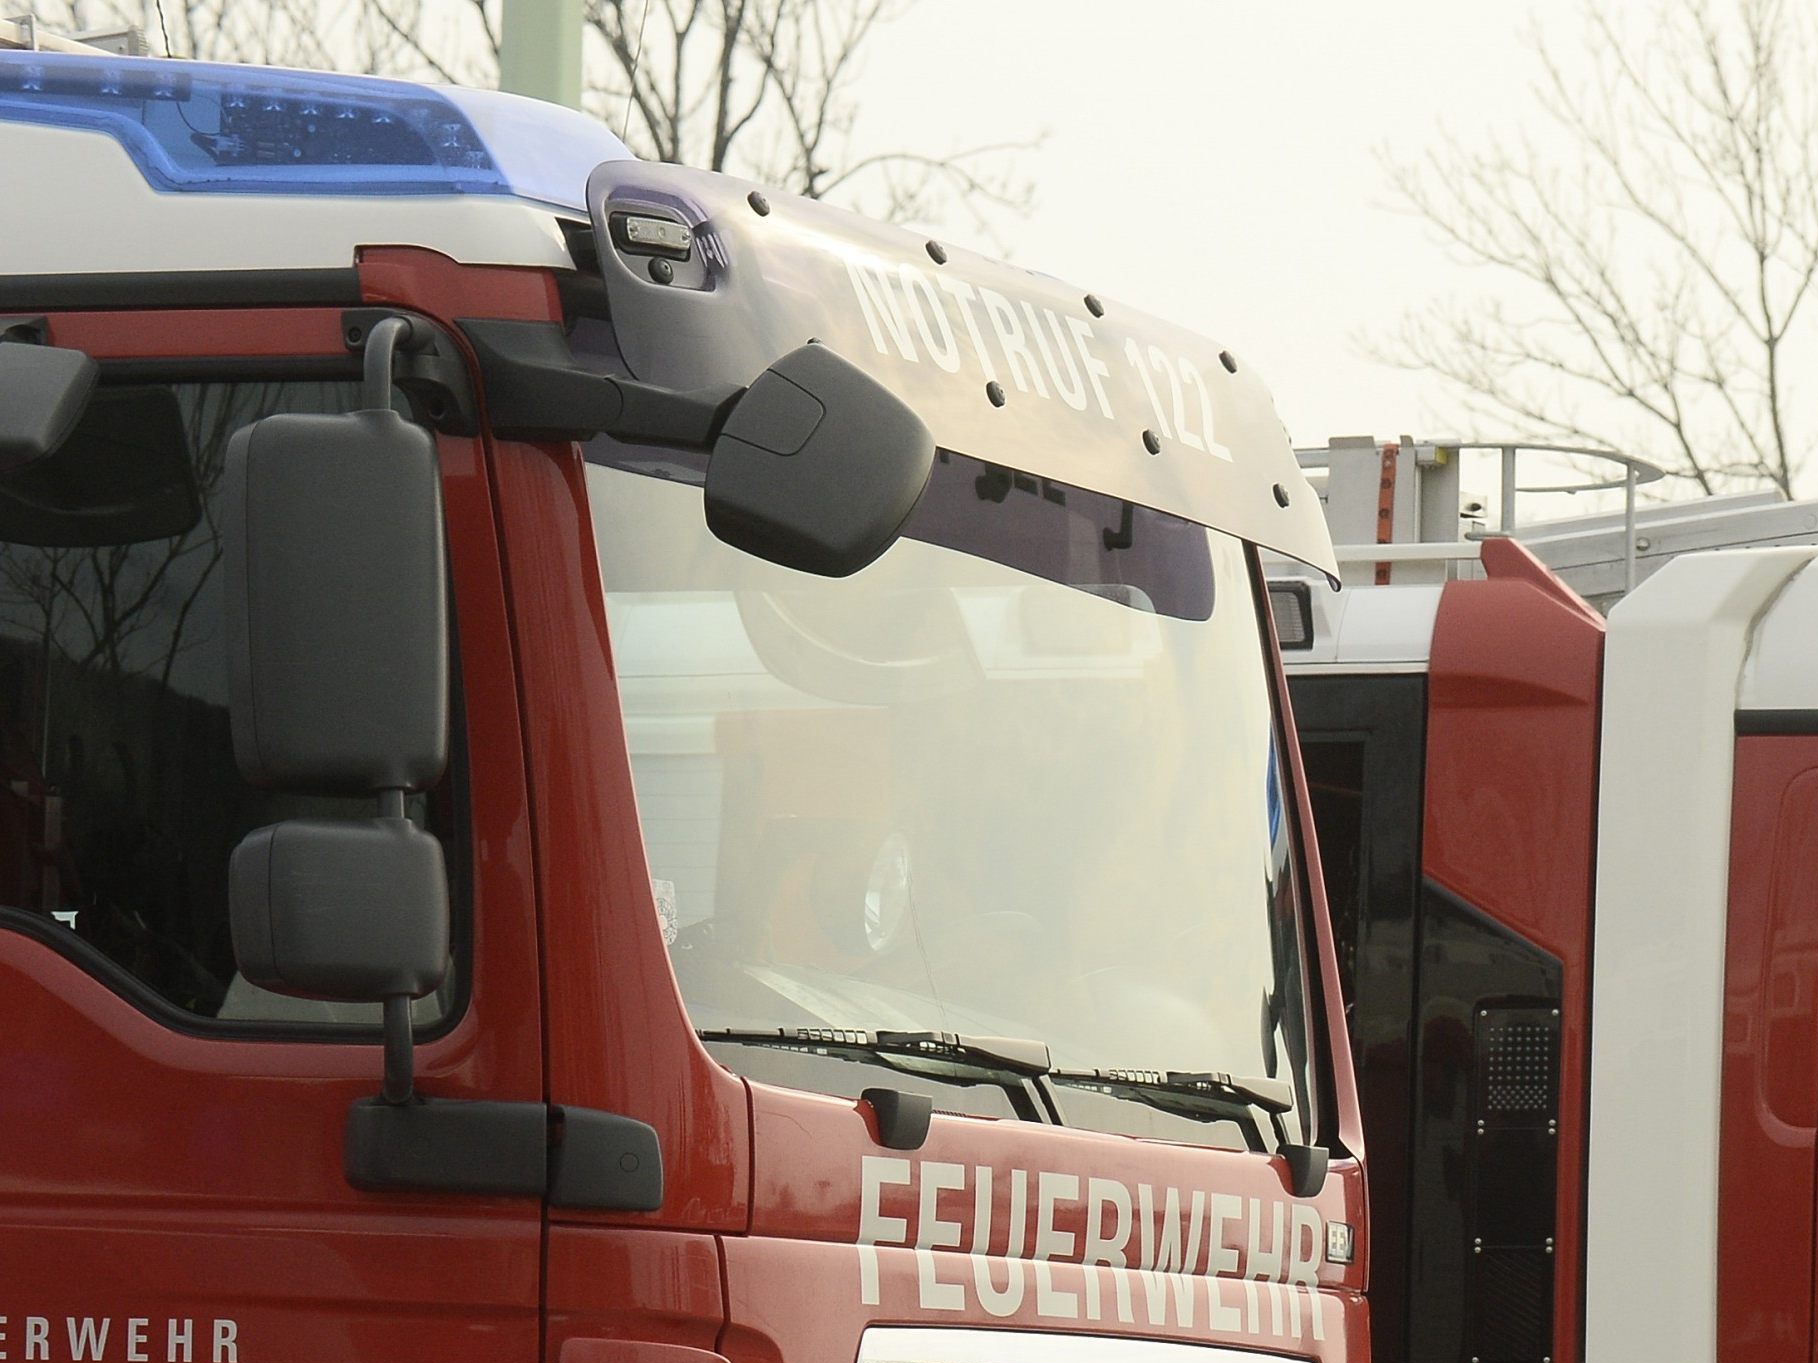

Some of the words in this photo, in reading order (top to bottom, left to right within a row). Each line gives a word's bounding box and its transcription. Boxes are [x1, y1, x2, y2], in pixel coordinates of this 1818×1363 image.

[842, 256, 1115, 419] NOTRUF
[1124, 337, 1233, 462] 122
[857, 1155, 1325, 1341] FEUERWEHR
